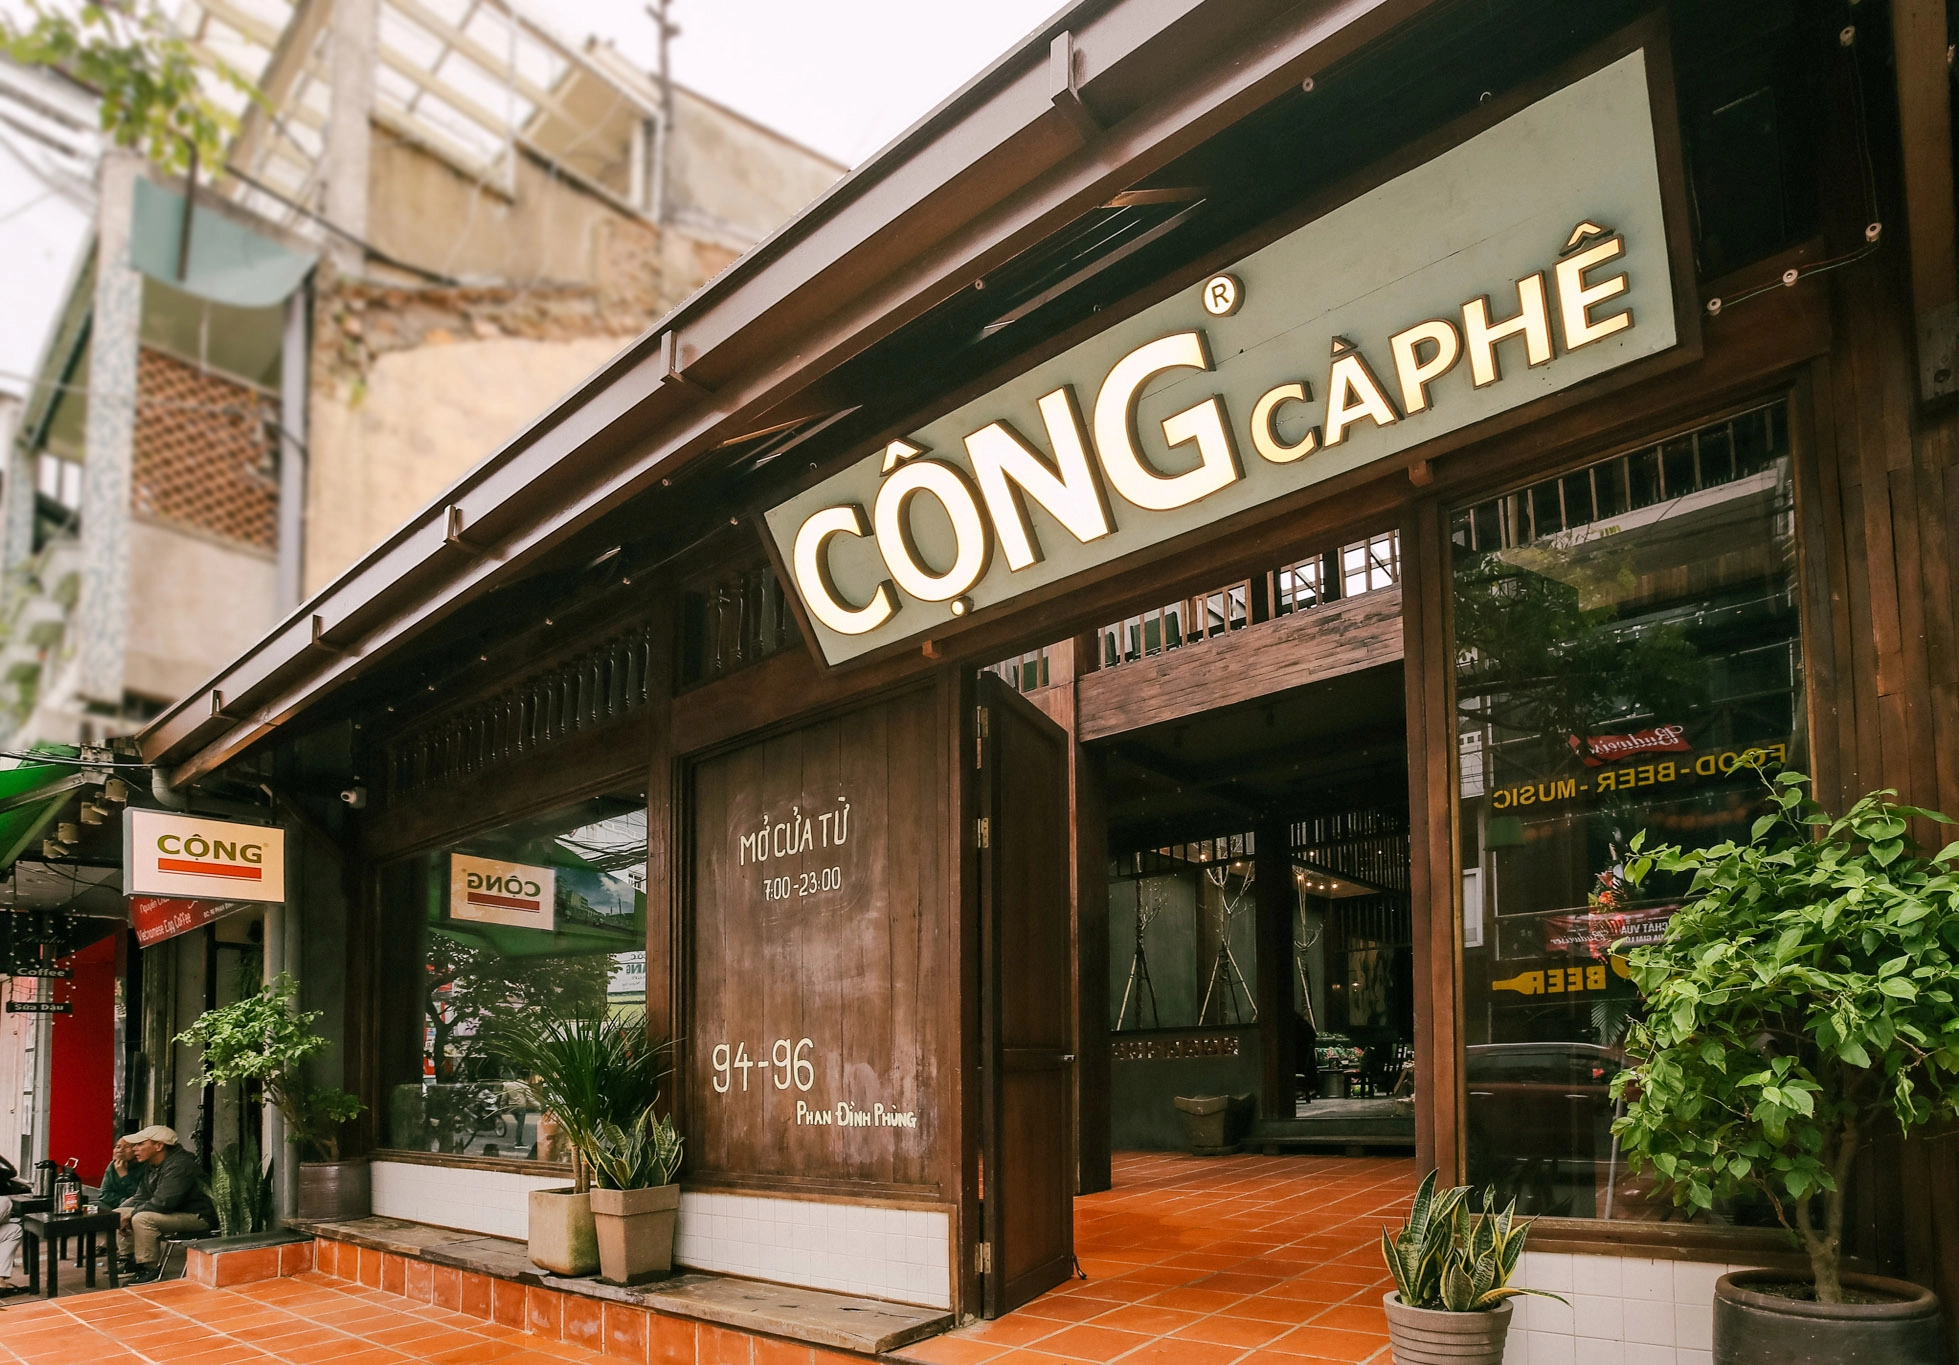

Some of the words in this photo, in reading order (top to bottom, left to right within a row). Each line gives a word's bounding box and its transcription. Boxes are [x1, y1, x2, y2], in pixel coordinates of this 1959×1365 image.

[793, 329, 1245, 634] CỘNG
[157, 834, 262, 864] CỘNG
[17, 967, 65, 977] Coffee
[712, 1038, 814, 1093] 94-96
